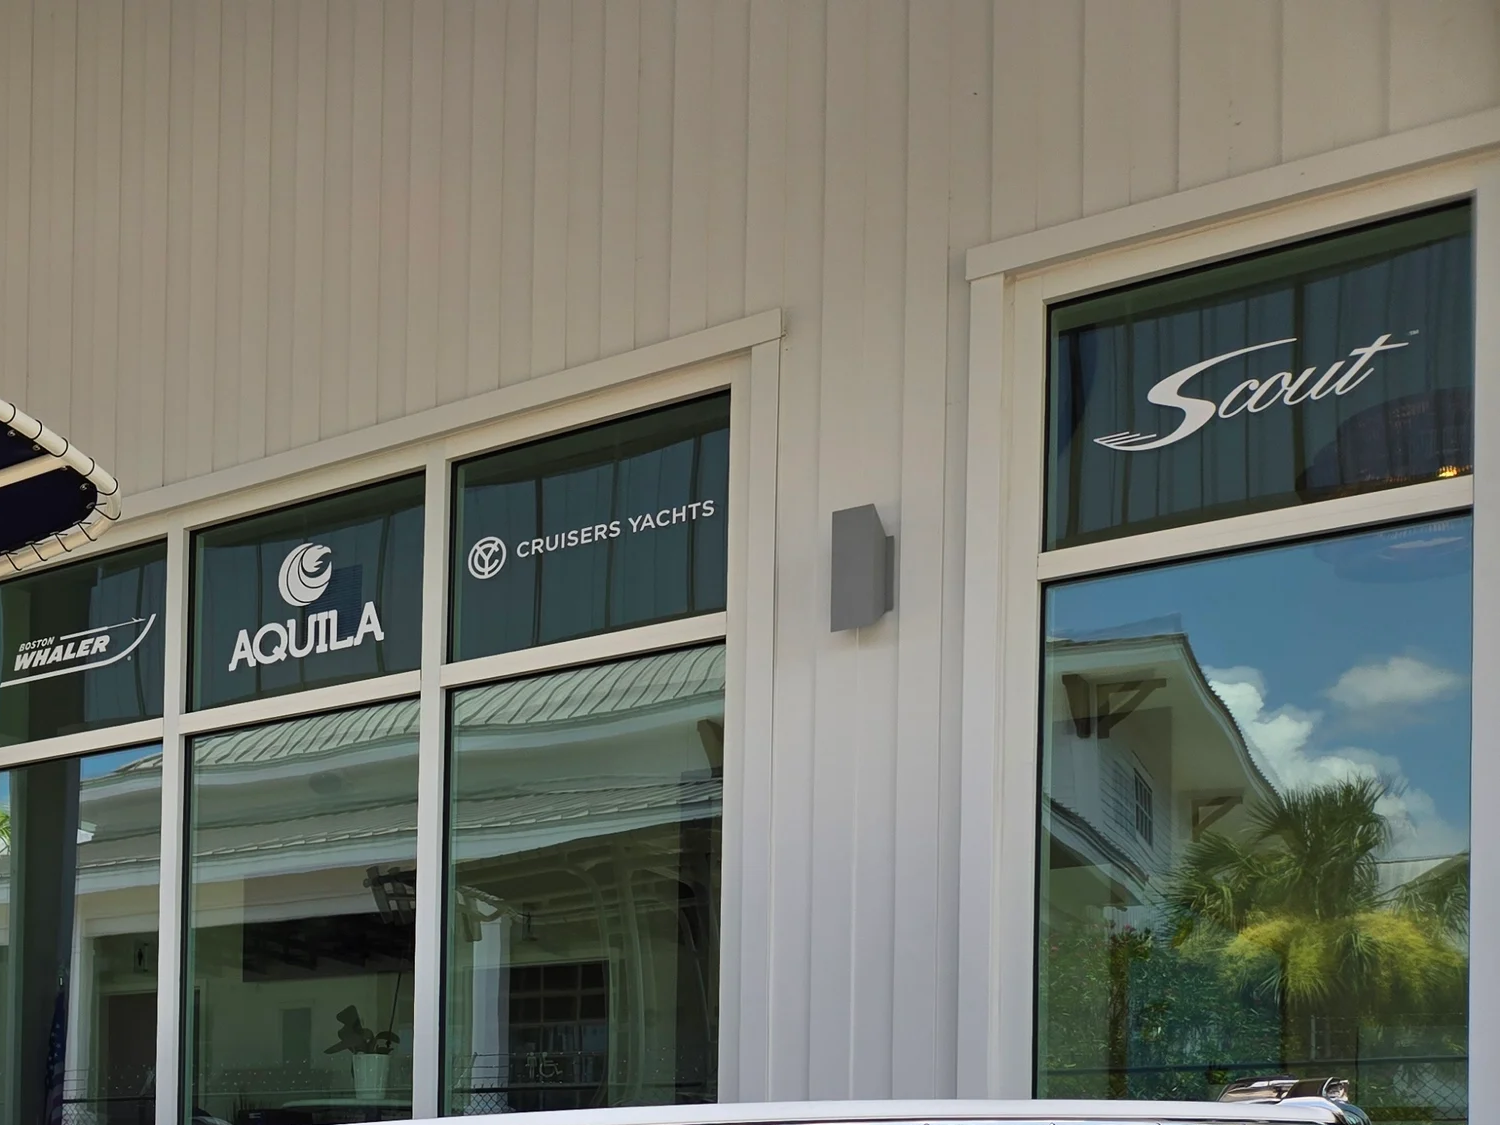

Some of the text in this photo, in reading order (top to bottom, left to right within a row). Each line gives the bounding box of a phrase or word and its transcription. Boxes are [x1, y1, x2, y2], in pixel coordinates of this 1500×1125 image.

[1093, 333, 1409, 452] Scout
[516, 500, 715, 558] CRUISERS YACHTS
[14, 634, 110, 671] WHALER
[19, 636, 55, 652] BOSTON
[228, 601, 385, 672] AQUILA
